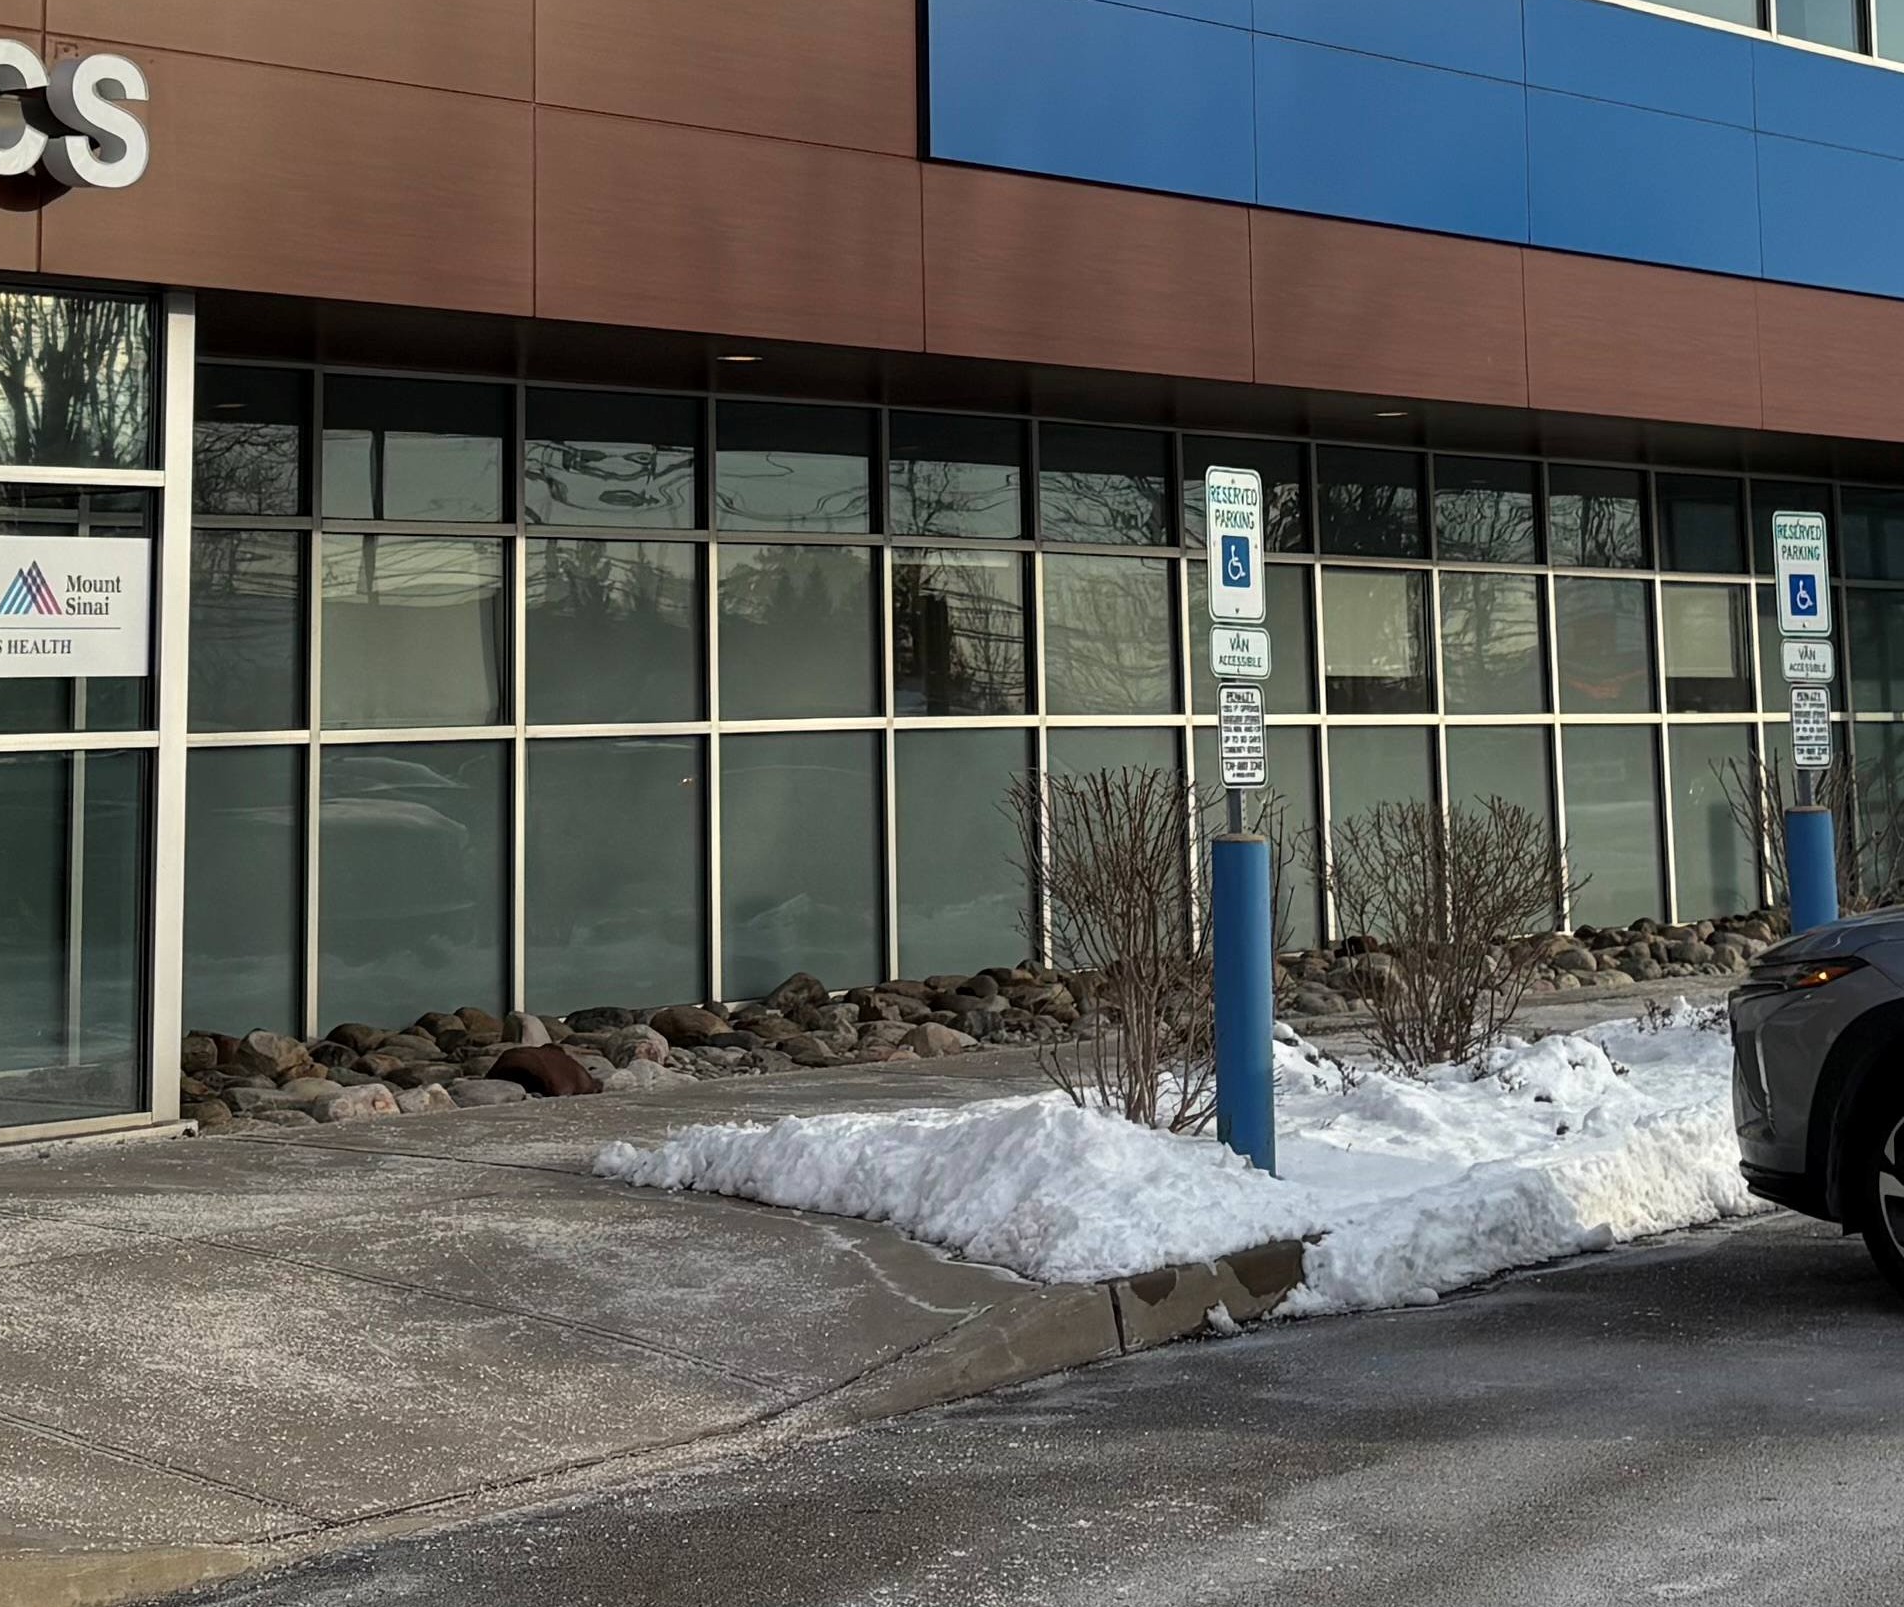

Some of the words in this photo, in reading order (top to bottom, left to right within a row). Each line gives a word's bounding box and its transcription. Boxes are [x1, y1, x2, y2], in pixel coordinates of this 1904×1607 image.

[1215, 508, 1255, 530] PARKING
[1777, 524, 1822, 541] RESERVED
[1781, 544, 1821, 561] PARKING
[65, 574, 122, 594] Mount
[65, 596, 110, 616] Sinai
[7, 639, 72, 655] HEALTH
[1229, 637, 1249, 653] VAN
